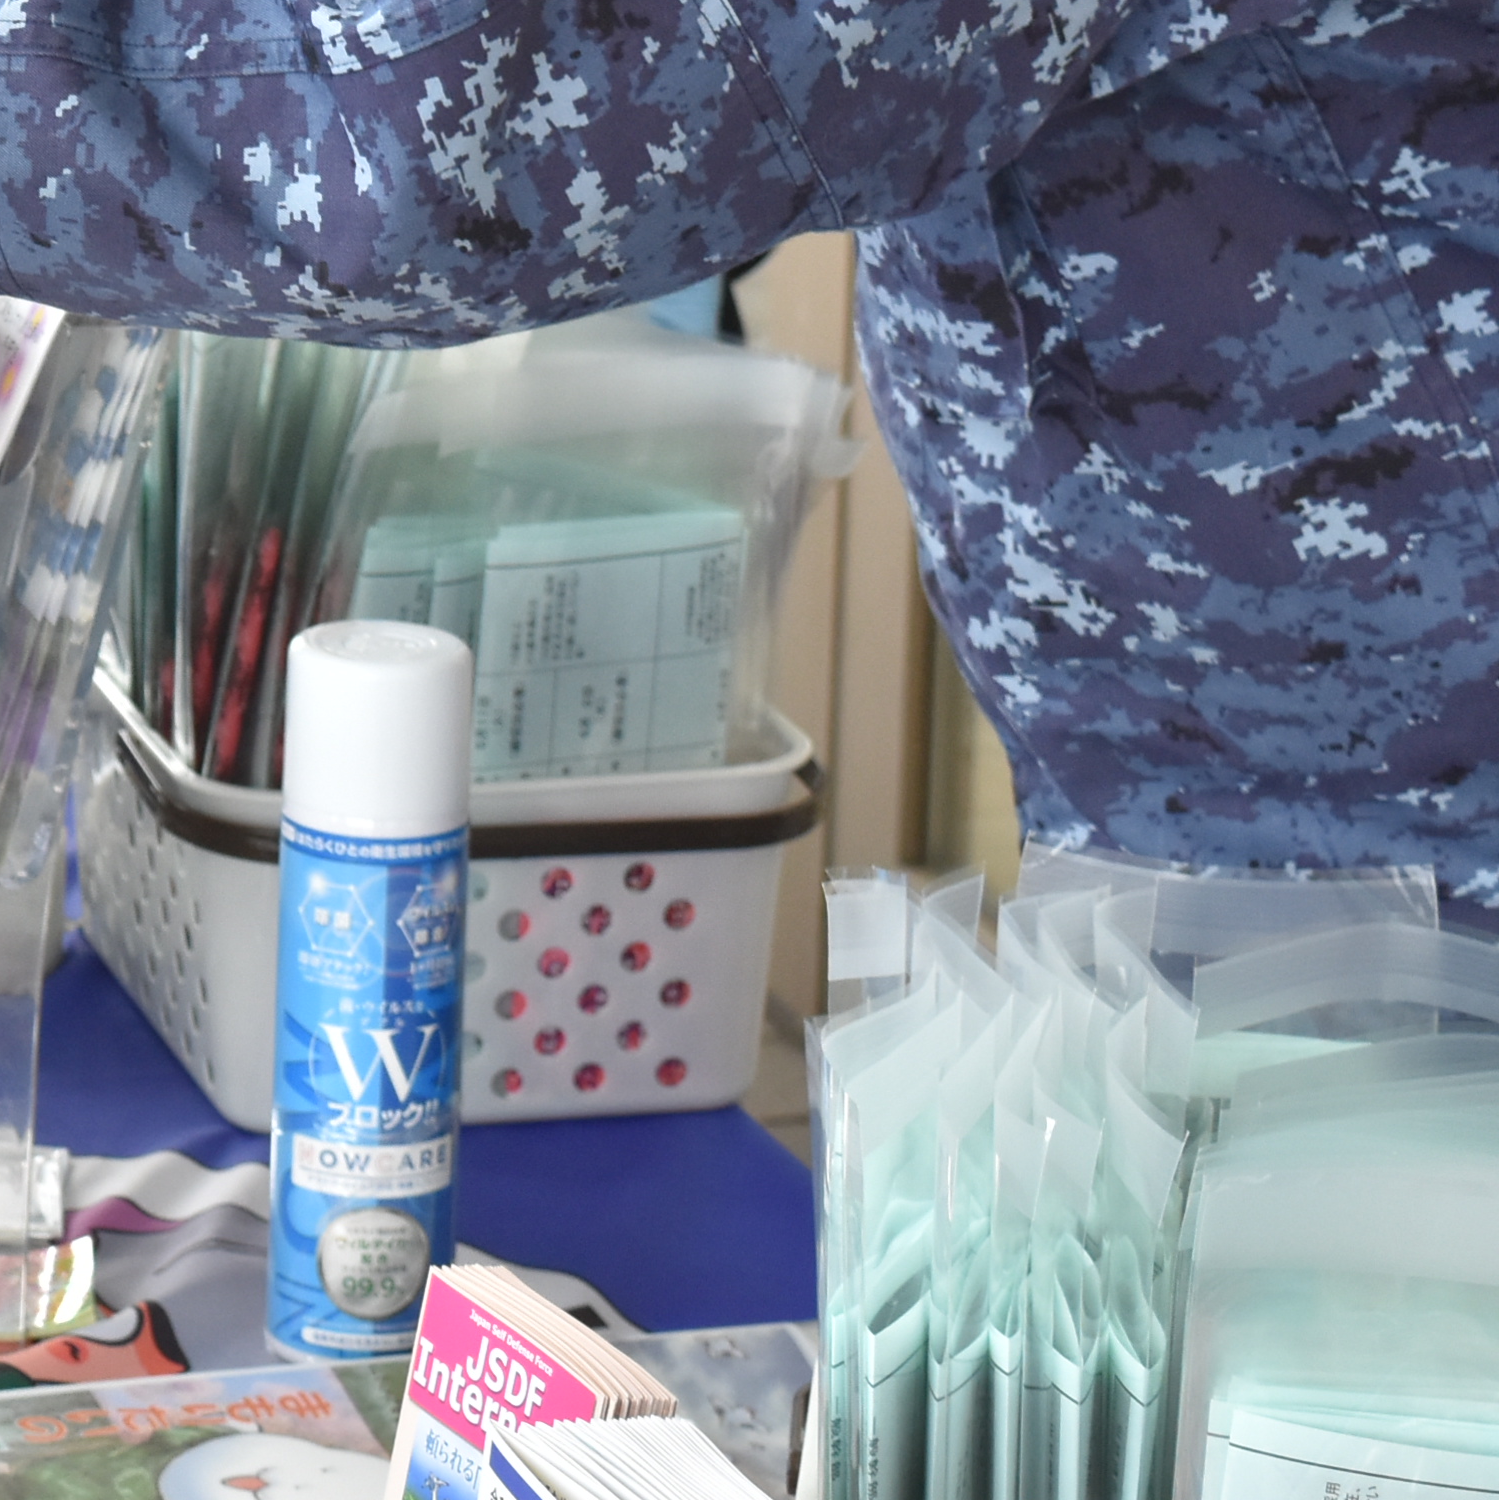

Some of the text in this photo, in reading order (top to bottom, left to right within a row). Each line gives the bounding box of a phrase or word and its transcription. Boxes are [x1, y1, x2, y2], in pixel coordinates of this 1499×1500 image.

[319, 1022, 440, 1103] W
[466, 1337, 546, 1418] JSDF
[469, 1308, 554, 1377] Japan Self Defense Force
[413, 1336, 536, 1435] Intern
